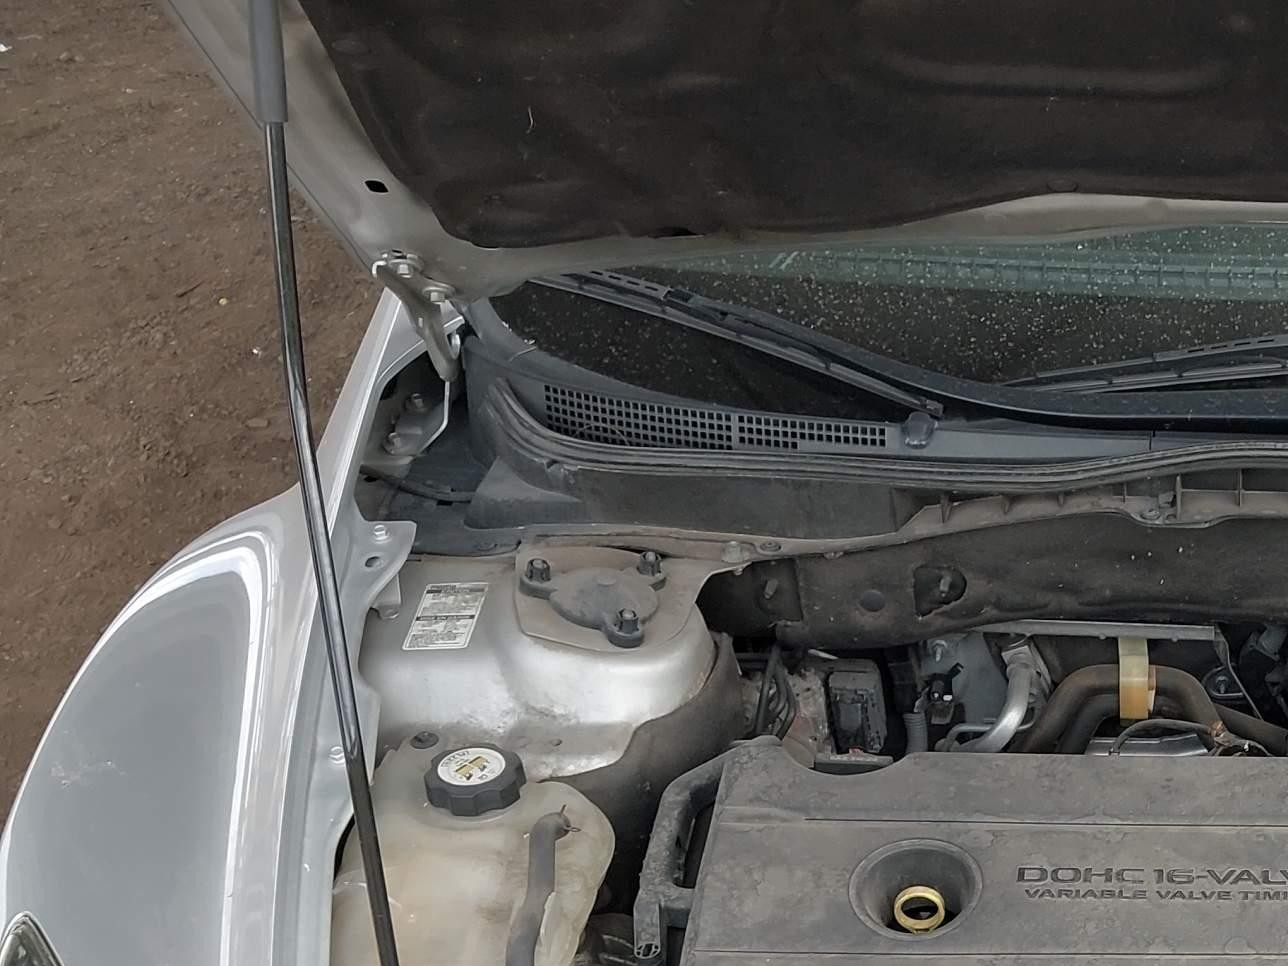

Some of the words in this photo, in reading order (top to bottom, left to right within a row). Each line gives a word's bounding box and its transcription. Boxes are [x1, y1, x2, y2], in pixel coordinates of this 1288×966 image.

[1016, 867, 1145, 884] DOHC
[1024, 888, 1148, 900] VARIABLE
[1156, 890, 1233, 900] VALVE
